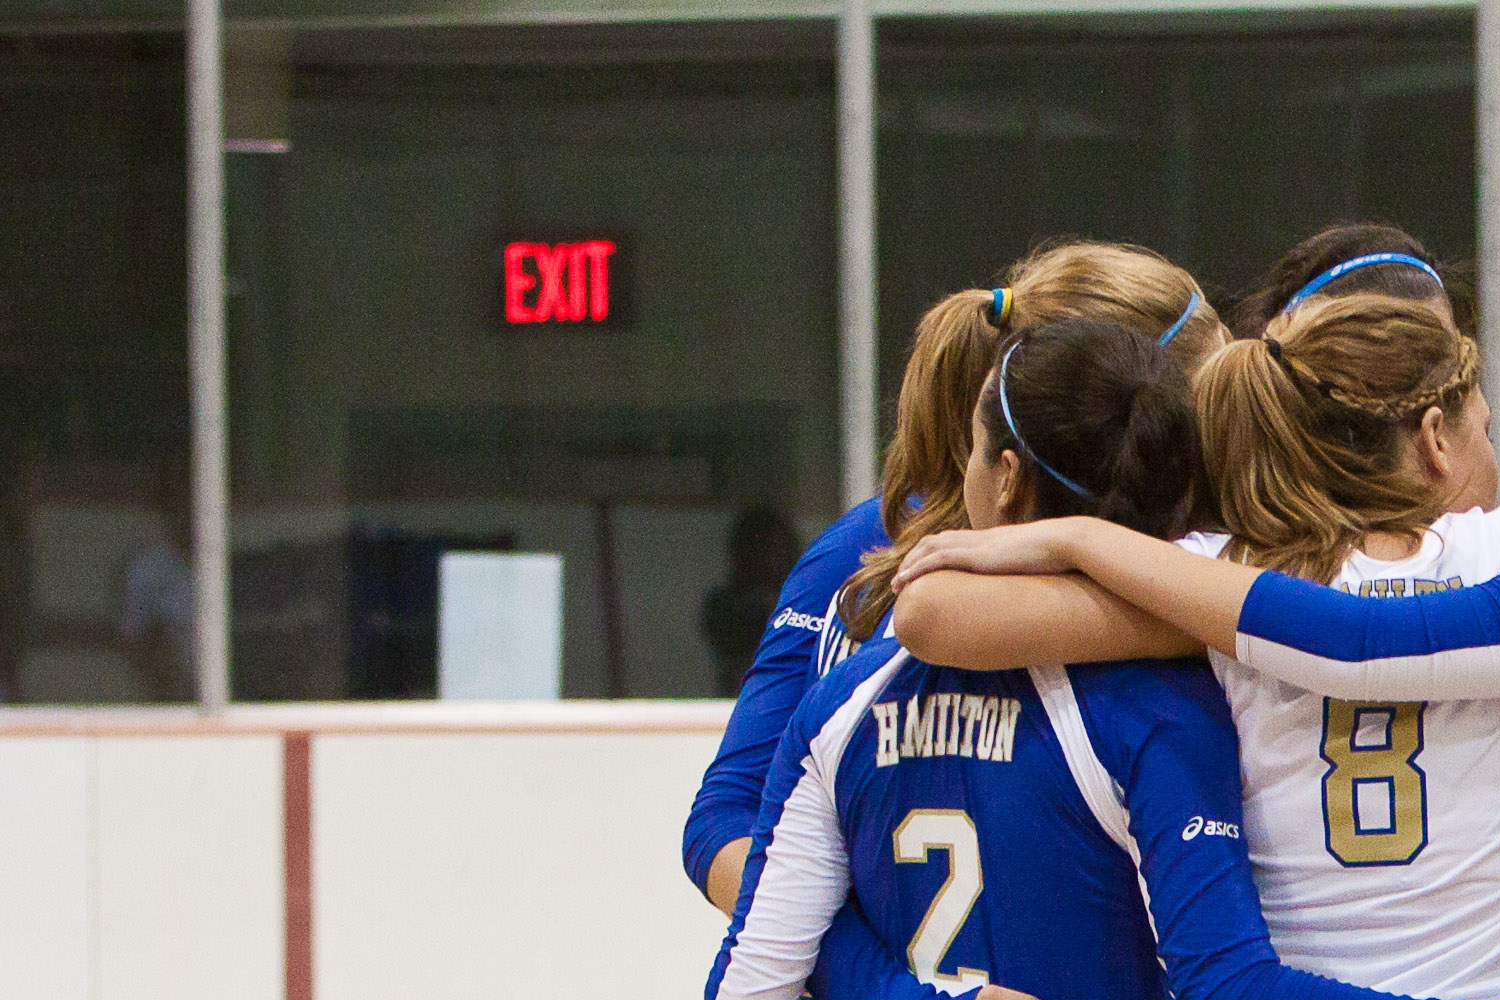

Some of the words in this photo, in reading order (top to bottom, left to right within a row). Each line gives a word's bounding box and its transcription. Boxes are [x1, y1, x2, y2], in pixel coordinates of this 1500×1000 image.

[504, 240, 616, 323] EXIT
[786, 611, 825, 632] asics
[1319, 697, 1429, 868] 8
[1203, 820, 1240, 839] asics
[893, 809, 989, 998] 2
